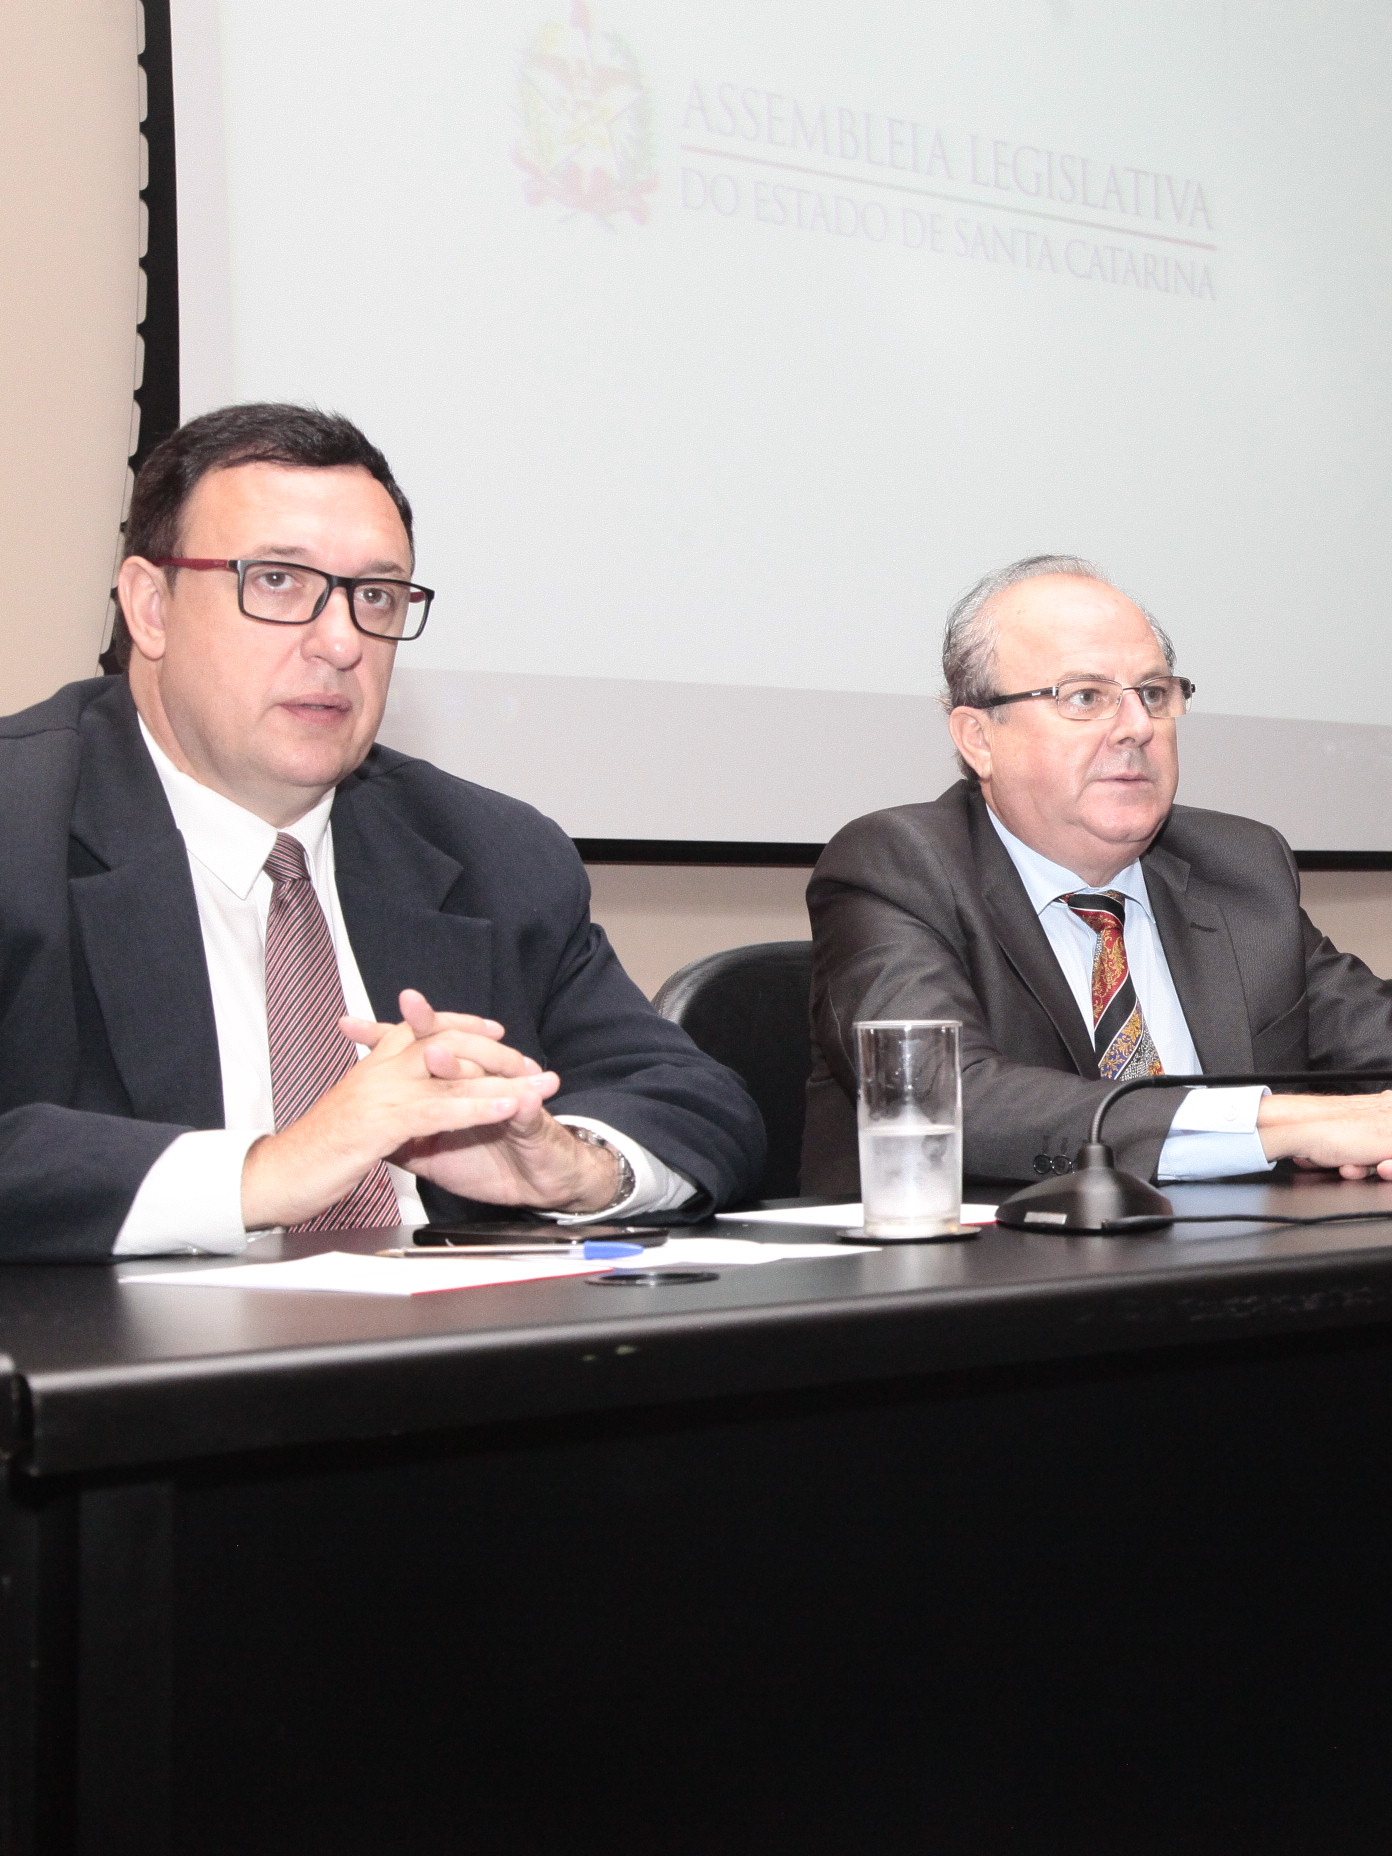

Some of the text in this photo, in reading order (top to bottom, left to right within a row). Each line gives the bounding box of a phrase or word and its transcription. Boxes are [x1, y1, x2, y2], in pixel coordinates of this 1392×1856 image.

[681, 78, 1214, 231] ASSEMBLEIA LEGISLATIVA
[681, 165, 1217, 302] DO ESTADO DE SANTA CATARINA
